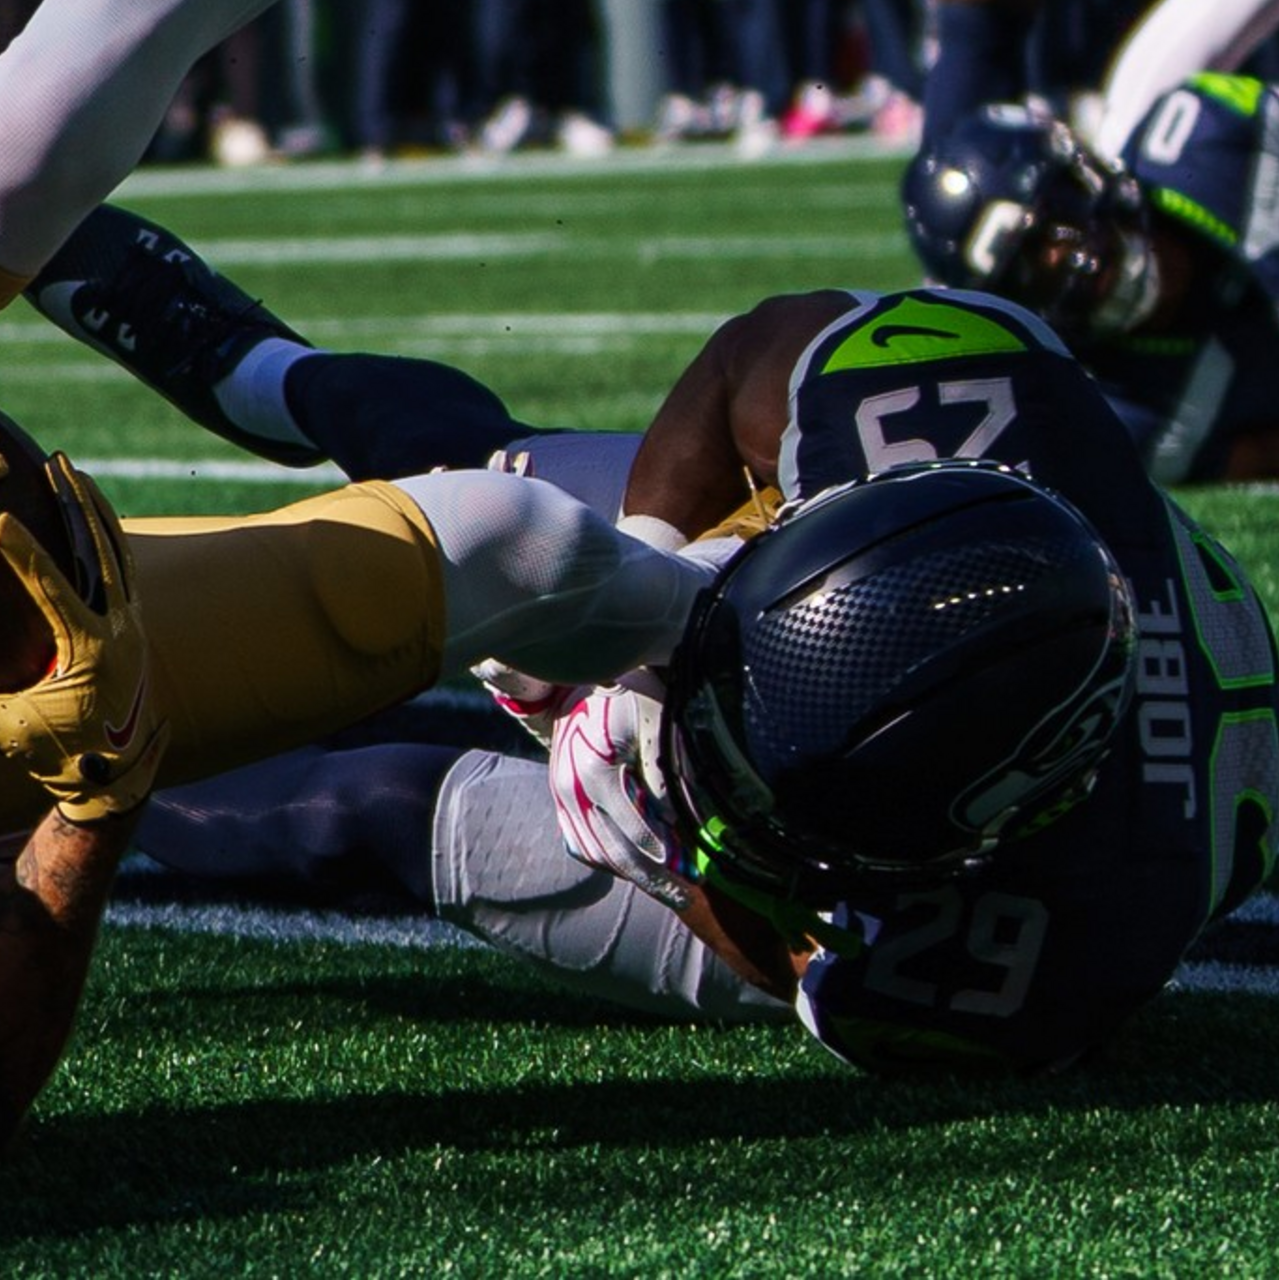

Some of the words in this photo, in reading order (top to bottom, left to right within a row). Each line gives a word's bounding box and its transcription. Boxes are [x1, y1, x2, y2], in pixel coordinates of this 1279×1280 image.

[1142, 99, 1202, 166] 0
[1134, 577, 1198, 821] JOBE
[862, 882, 1050, 1019] 29
